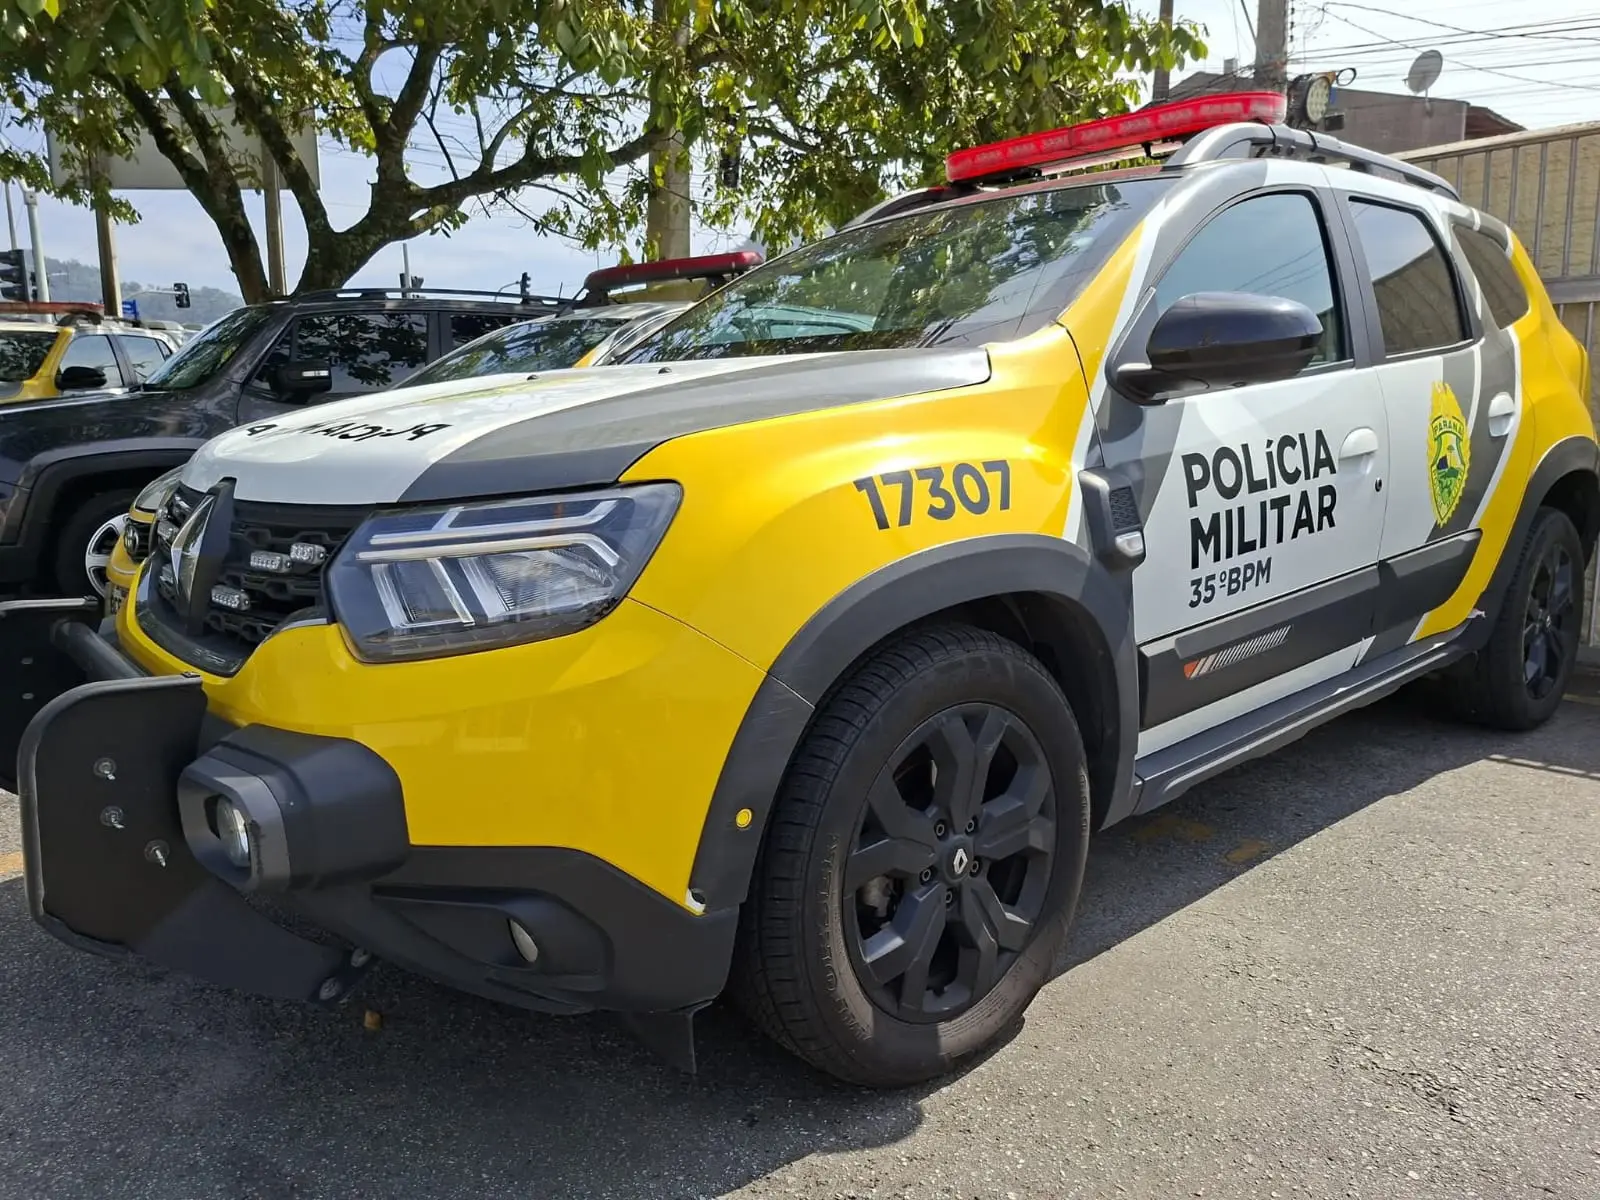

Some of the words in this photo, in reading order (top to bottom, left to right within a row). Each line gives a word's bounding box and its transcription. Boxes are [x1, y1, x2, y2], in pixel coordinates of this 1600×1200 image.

[853, 459, 1010, 531] 17307
[1181, 429, 1337, 508] POLÍCIA
[1190, 484, 1337, 570] MILITAR
